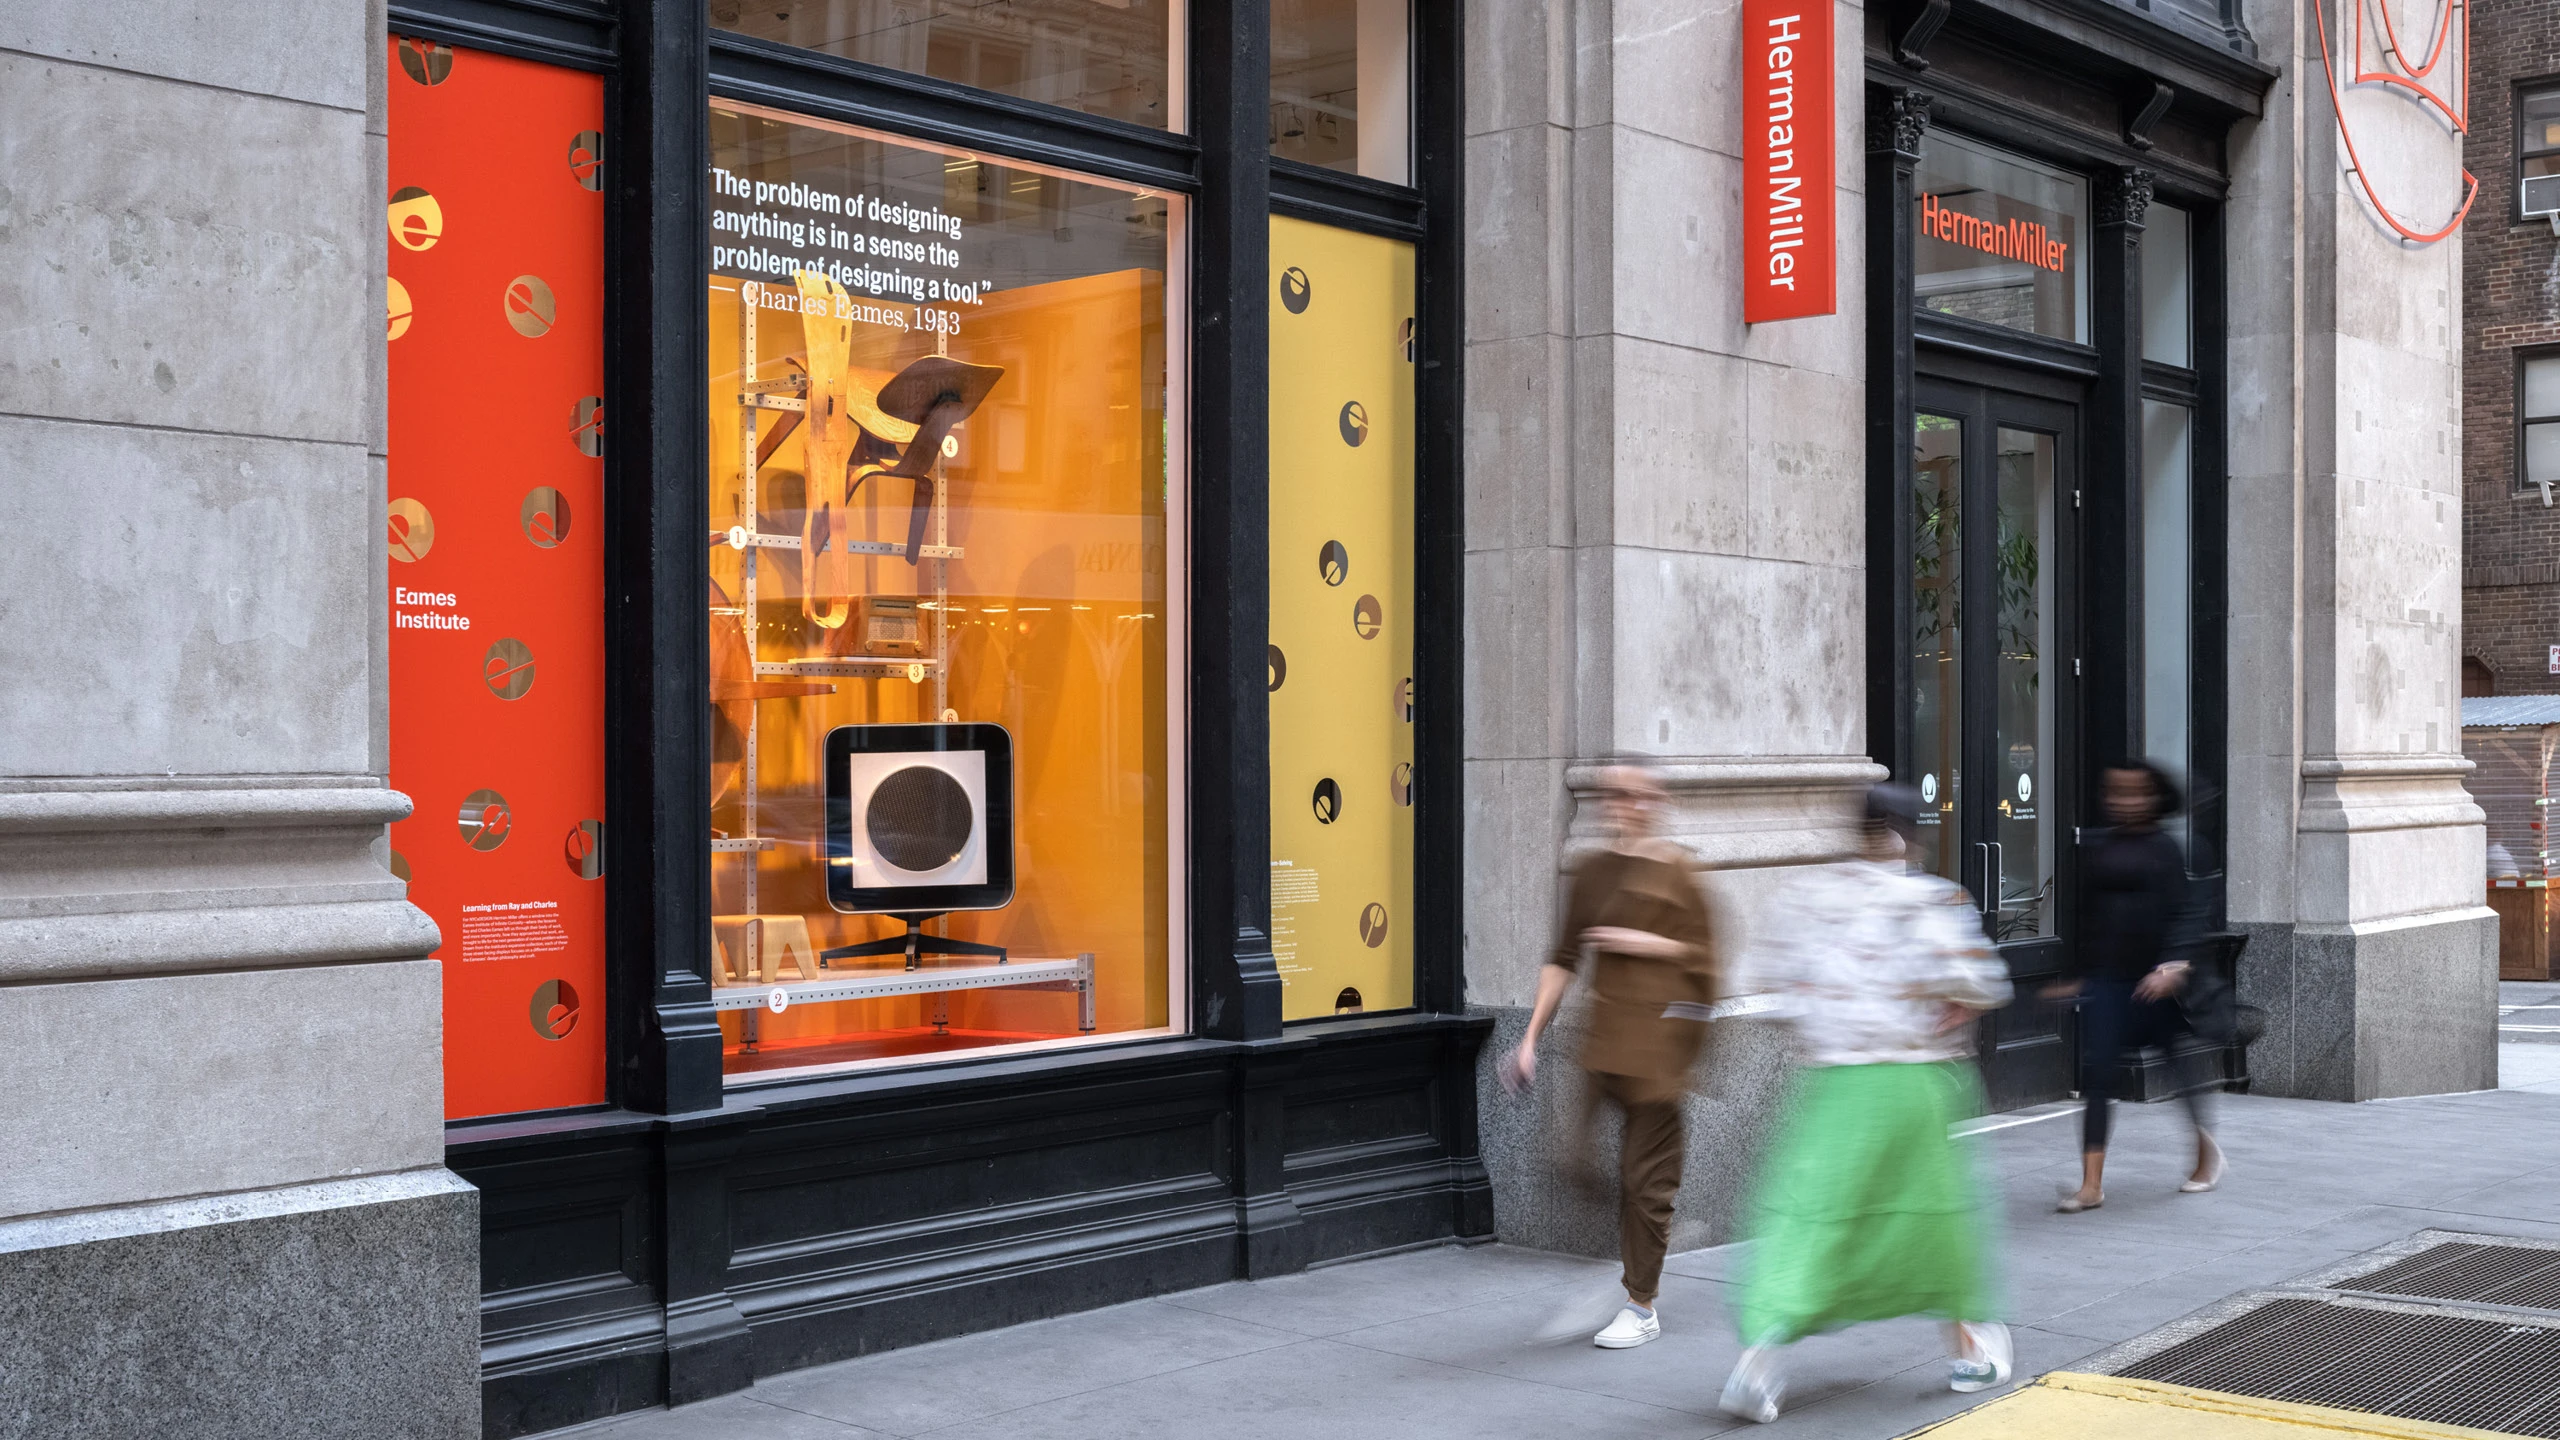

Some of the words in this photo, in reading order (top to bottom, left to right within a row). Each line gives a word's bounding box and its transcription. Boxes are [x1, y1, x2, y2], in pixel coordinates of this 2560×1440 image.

[1768, 14, 1804, 292] HermanMiller
[708, 163, 751, 199] The
[756, 182, 841, 215] problem
[845, 194, 864, 218] of
[868, 197, 962, 240] designing
[713, 209, 805, 248] anything
[809, 219, 826, 247] is
[830, 222, 849, 250] in
[853, 234, 865, 253] a
[869, 236, 925, 263] sense
[928, 242, 959, 268] the
[1922, 192, 2067, 273] HermanMiller
[713, 245, 801, 276] problem
[805, 257, 825, 280] of
[829, 259, 924, 301] designing
[928, 279, 940, 299] a
[943, 280, 992, 306] tool.”
[742, 281, 827, 317] Charles
[835, 293, 909, 333] Eames,
[914, 306, 961, 336] 1953
[396, 587, 456, 606] Eames
[396, 610, 470, 630] Institute
[462, 904, 492, 912] Learning
[492, 903, 508, 911] from
[508, 902, 520, 911] Ray
[520, 902, 533, 910] and
[533, 900, 558, 909] Charles
[774, 992, 783, 1007] 2
